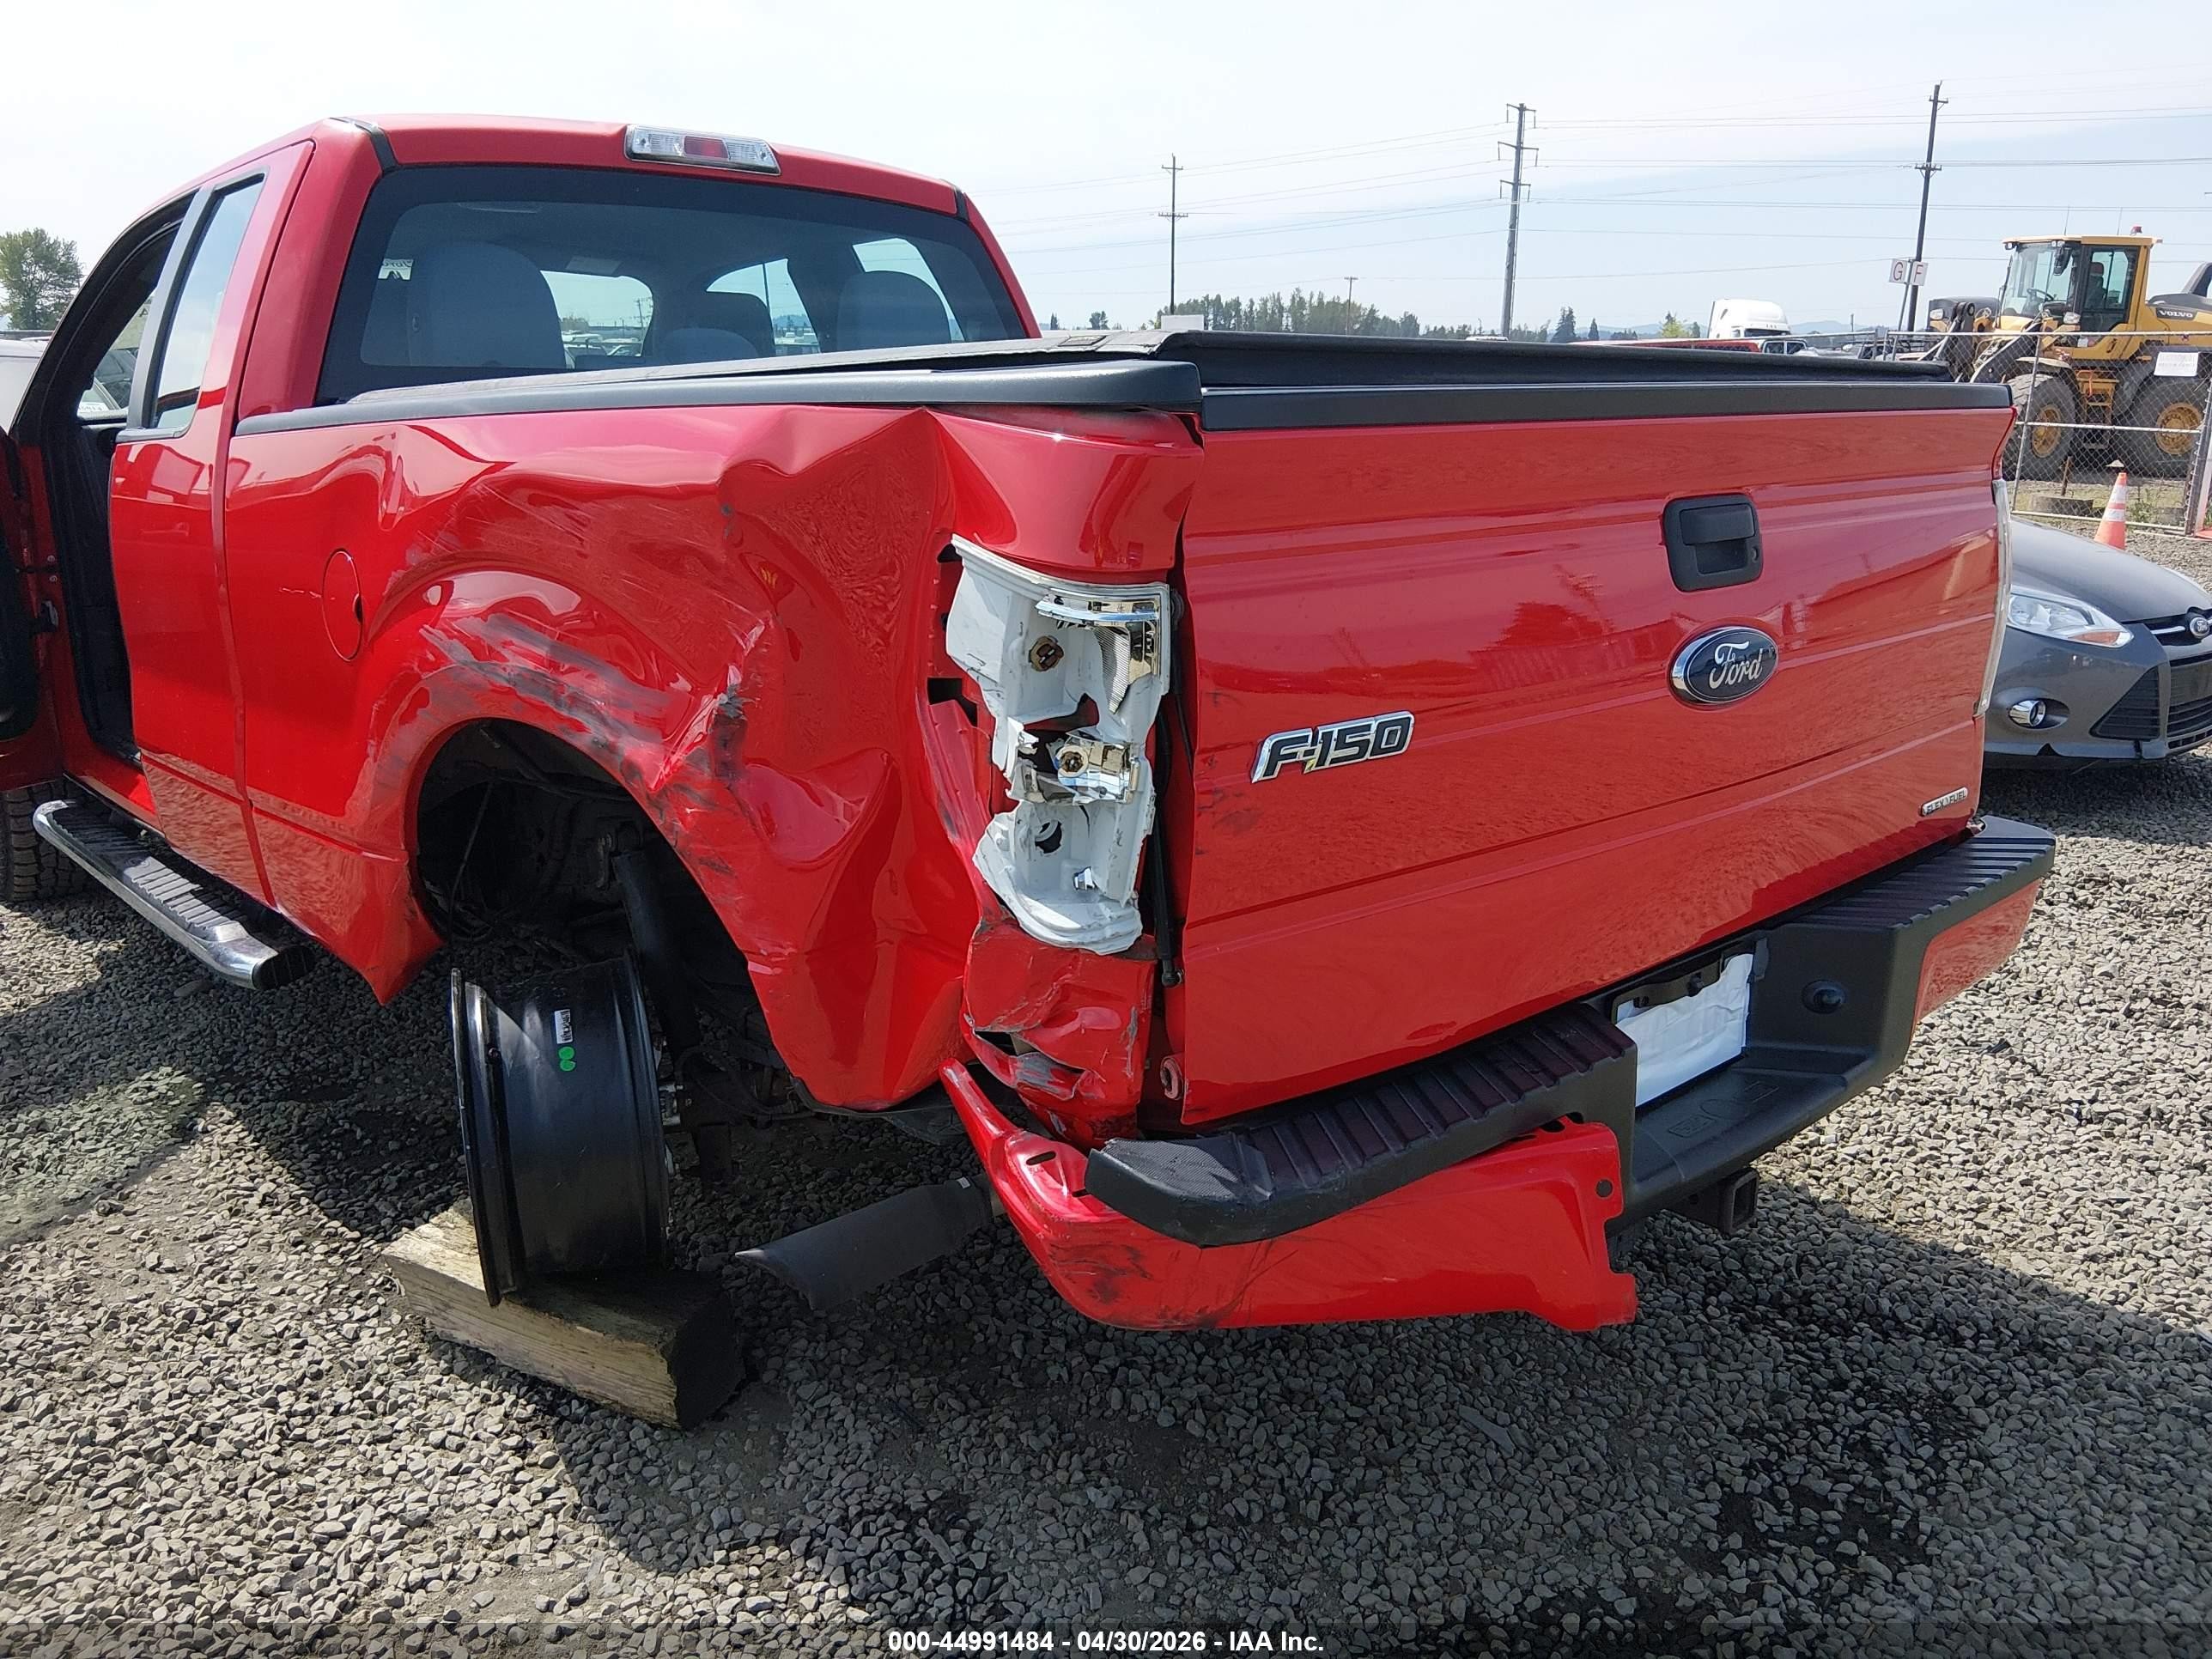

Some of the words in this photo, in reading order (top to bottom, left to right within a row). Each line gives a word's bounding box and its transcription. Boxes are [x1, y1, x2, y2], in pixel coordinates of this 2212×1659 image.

[1893, 261, 1903, 281] G
[1914, 264, 1923, 283] F
[1710, 641, 1763, 689] Ford
[1252, 711, 1415, 783] F-150
[1949, 790, 1966, 804] FUEL
